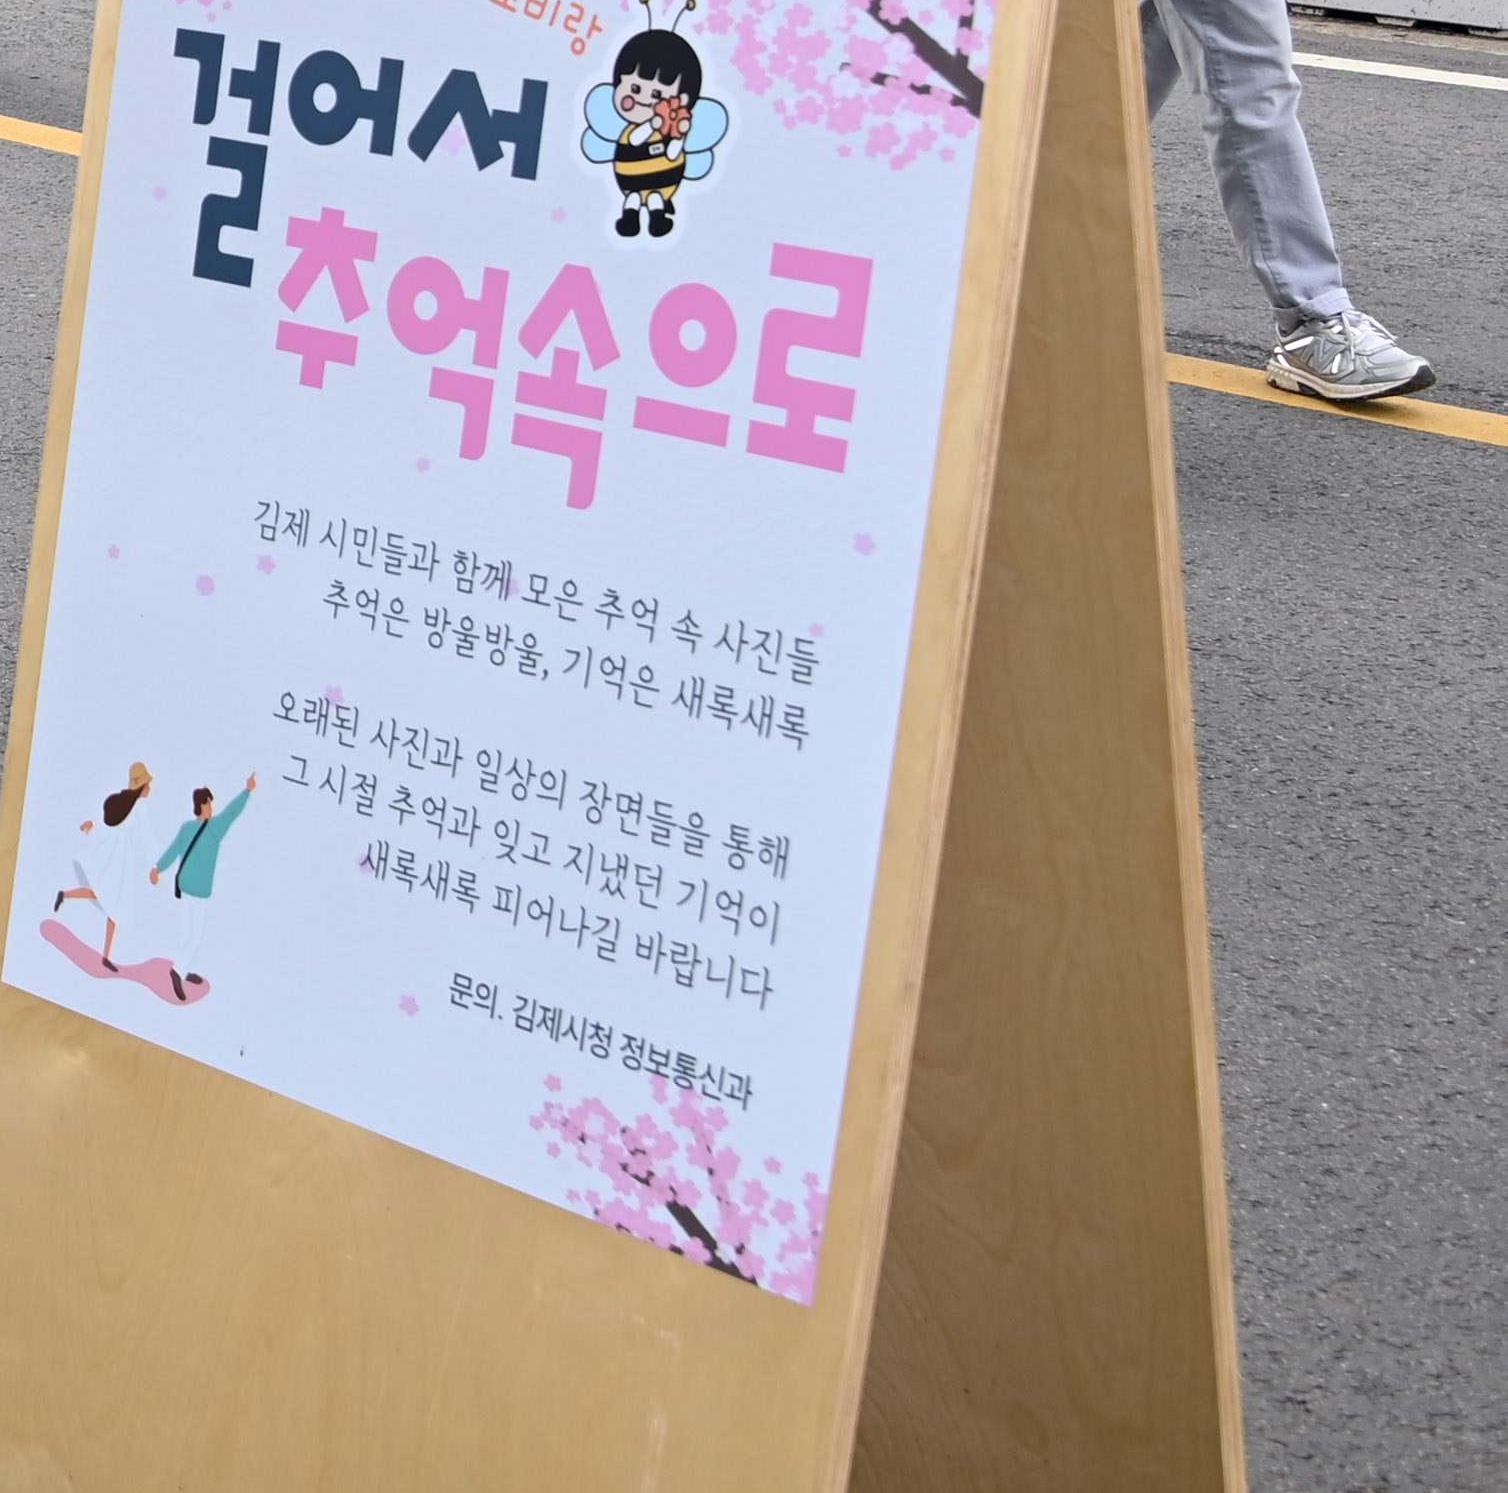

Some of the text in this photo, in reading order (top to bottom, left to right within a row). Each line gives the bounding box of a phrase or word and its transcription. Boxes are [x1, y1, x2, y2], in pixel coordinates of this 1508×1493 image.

[173, 27, 549, 289] 걸어서
[276, 206, 874, 510] 추억속으로
[253, 500, 820, 685] 김제 시민들과 함께 모은 추억 속 사진들
[322, 578, 810, 751] 추억은 방울방울, 기억은 새록새록
[273, 691, 790, 880] 오래된 사진과 일상의 장면들을 통해
[282, 755, 780, 946] 그 시절 추억과 잊고 지냈던 기억이
[359, 839, 773, 1011] 새록새록 피어나길 바랍니다
[448, 972, 753, 1111] 문의. 김제시청 정보통신과
